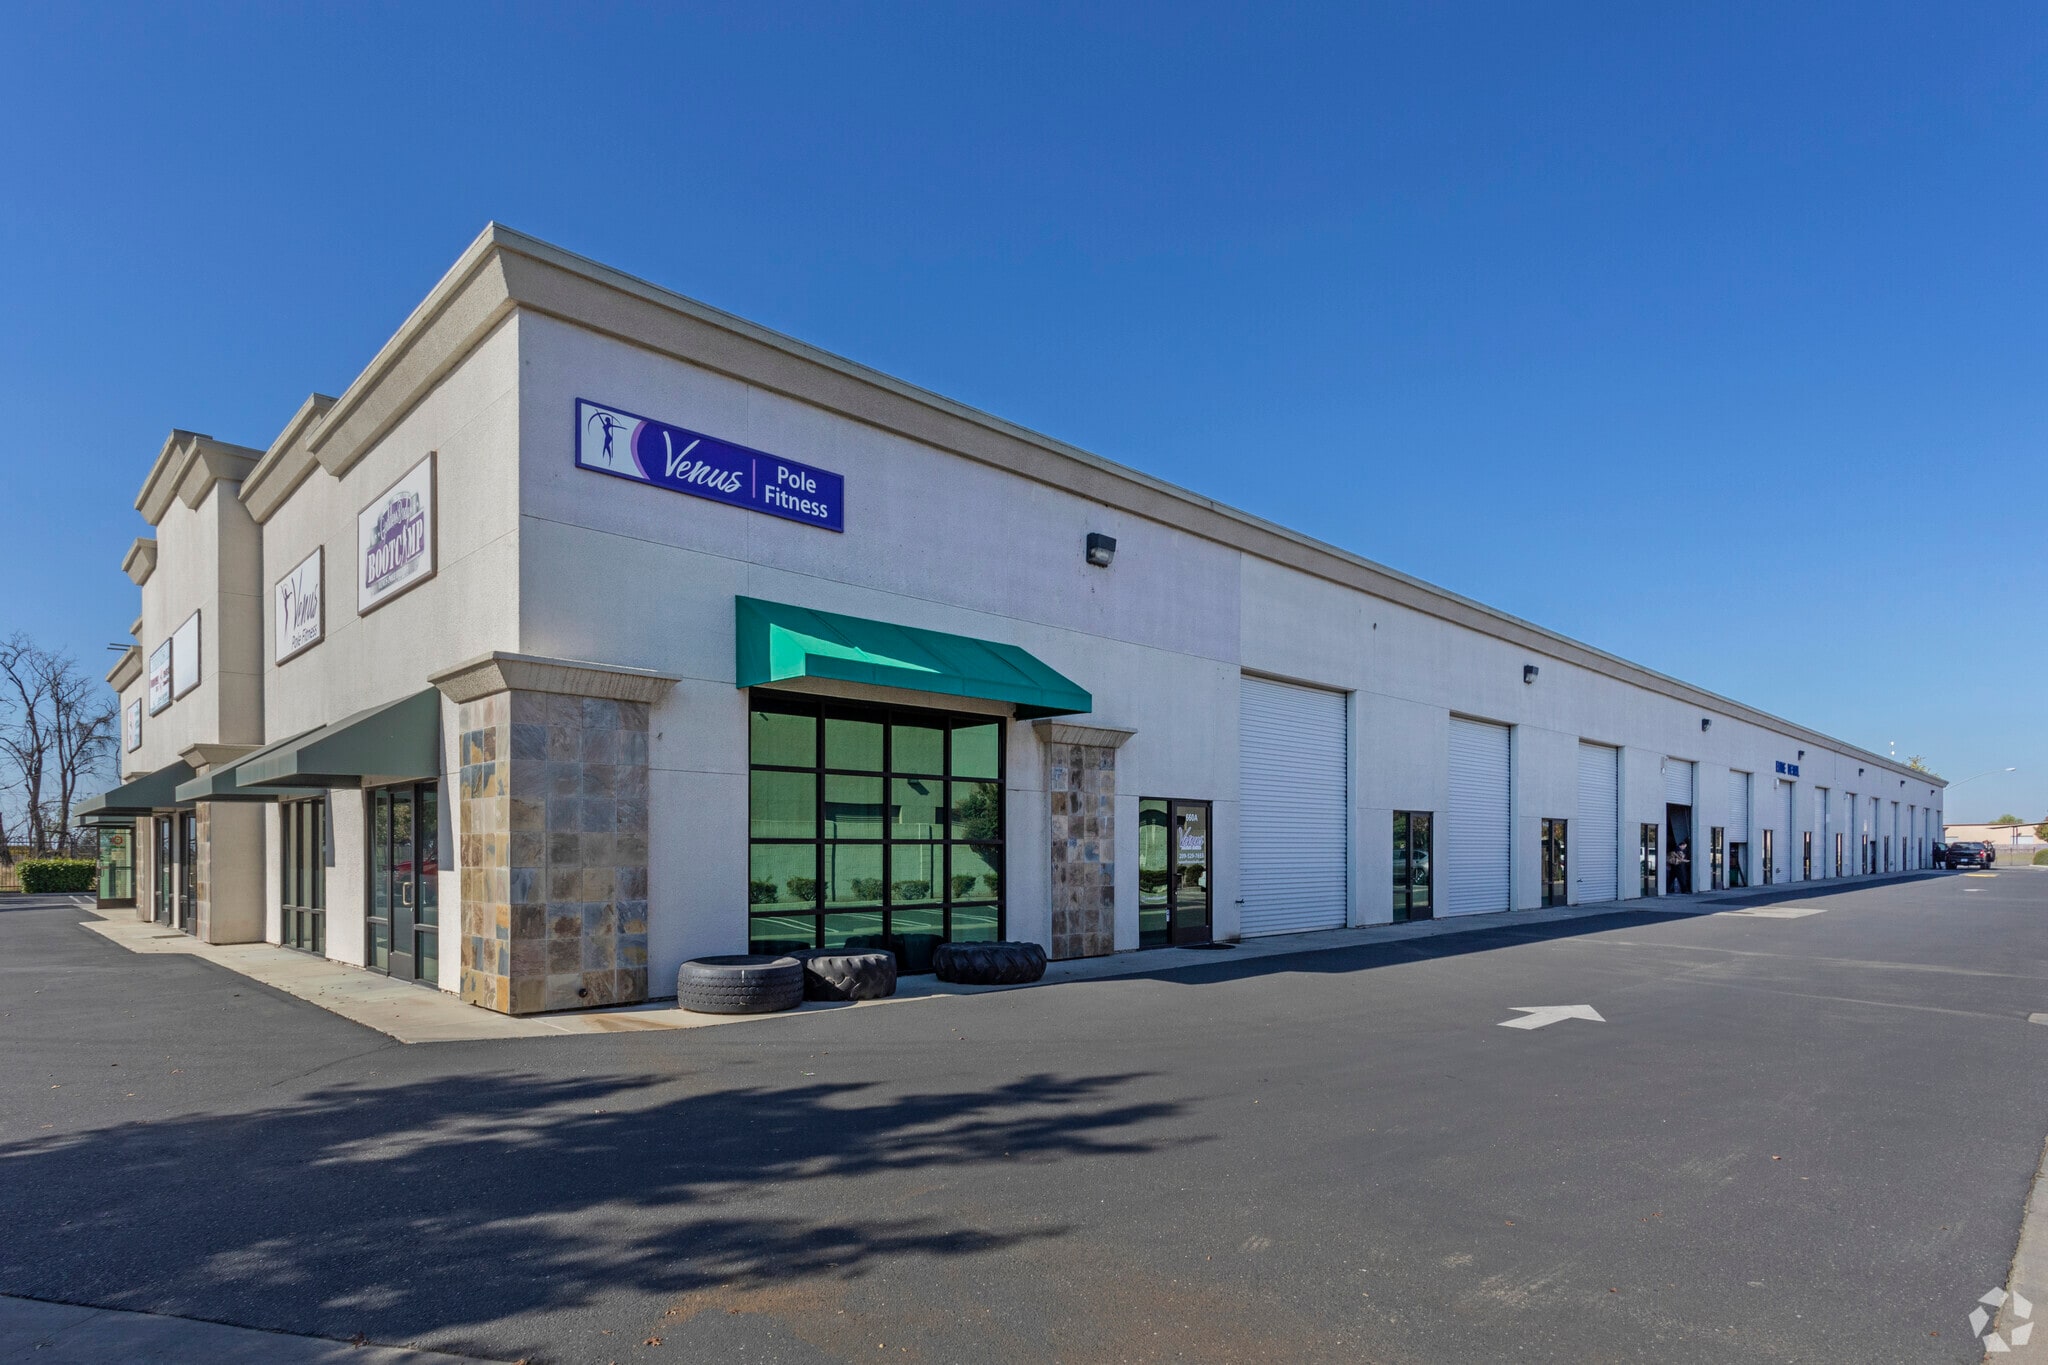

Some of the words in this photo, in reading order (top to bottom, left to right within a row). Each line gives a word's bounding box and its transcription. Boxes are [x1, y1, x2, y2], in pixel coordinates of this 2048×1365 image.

[663, 431, 743, 493] Venus
[777, 466, 817, 494] Pole
[765, 484, 828, 518] Fitness
[291, 568, 319, 630] Venus
